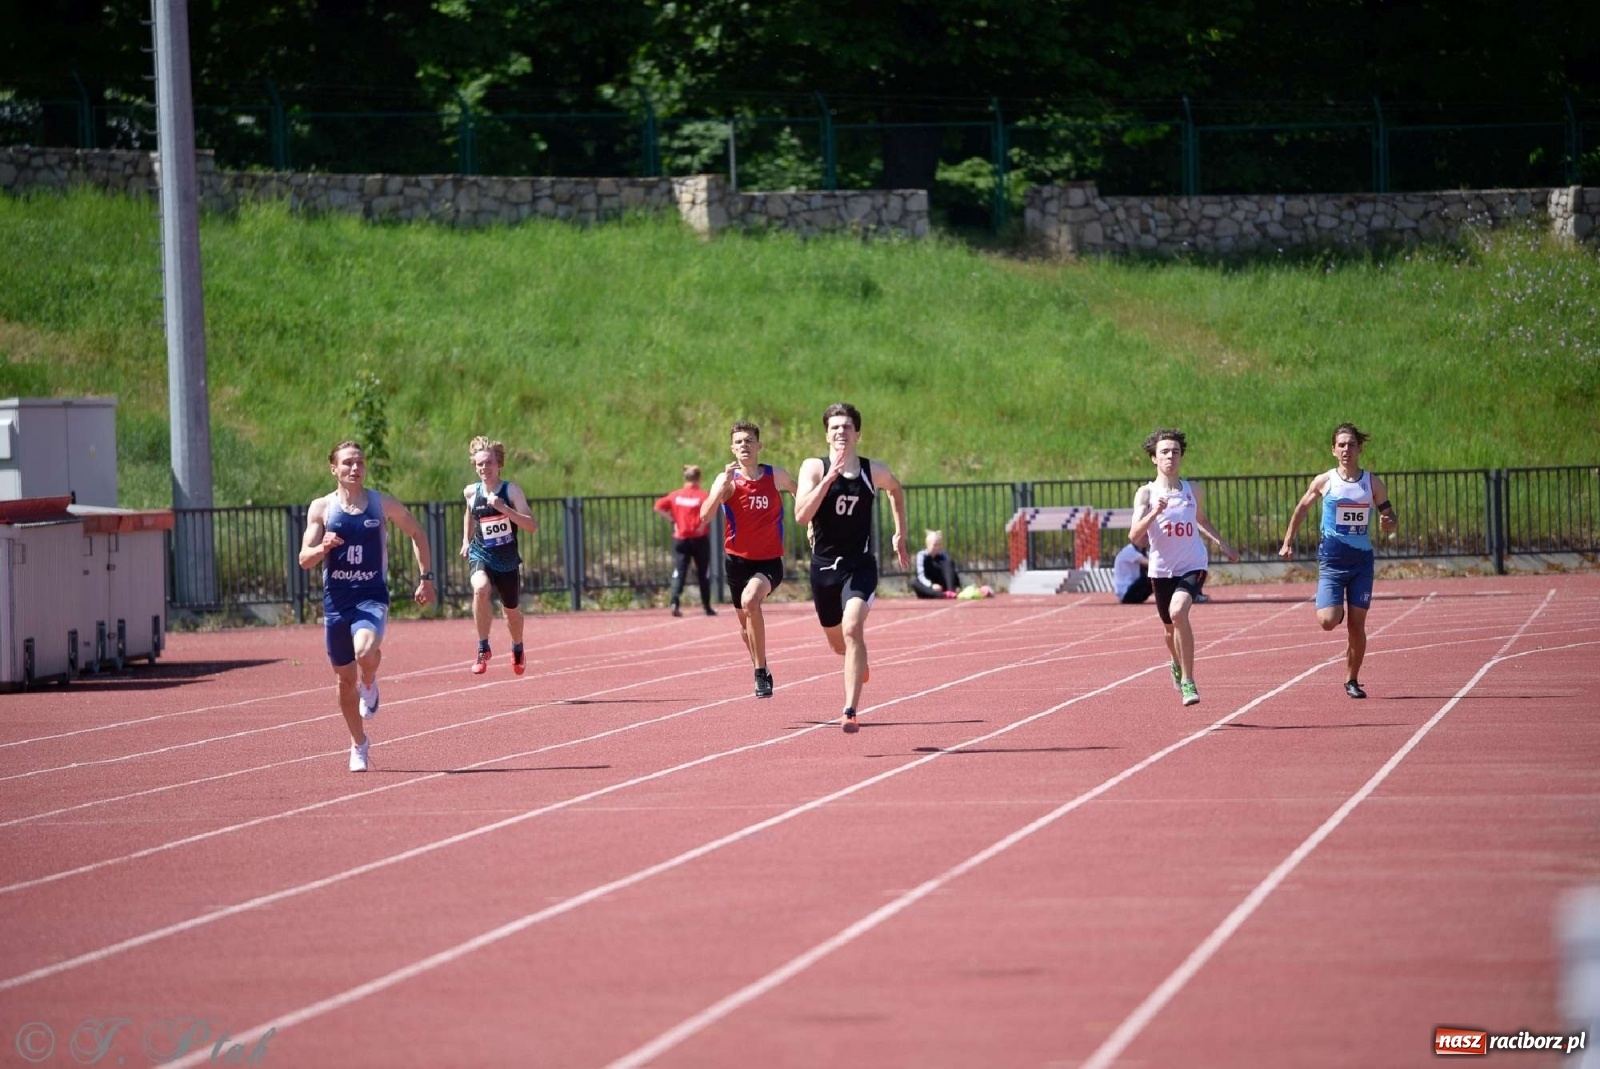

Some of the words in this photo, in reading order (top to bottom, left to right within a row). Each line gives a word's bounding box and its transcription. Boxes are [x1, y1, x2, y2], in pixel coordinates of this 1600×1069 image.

[748, 495, 769, 510] 759
[835, 494, 859, 516] 67
[1343, 511, 1364, 522] 516
[485, 522, 508, 536] 500
[1164, 521, 1193, 537] 160
[346, 544, 363, 565] 43
